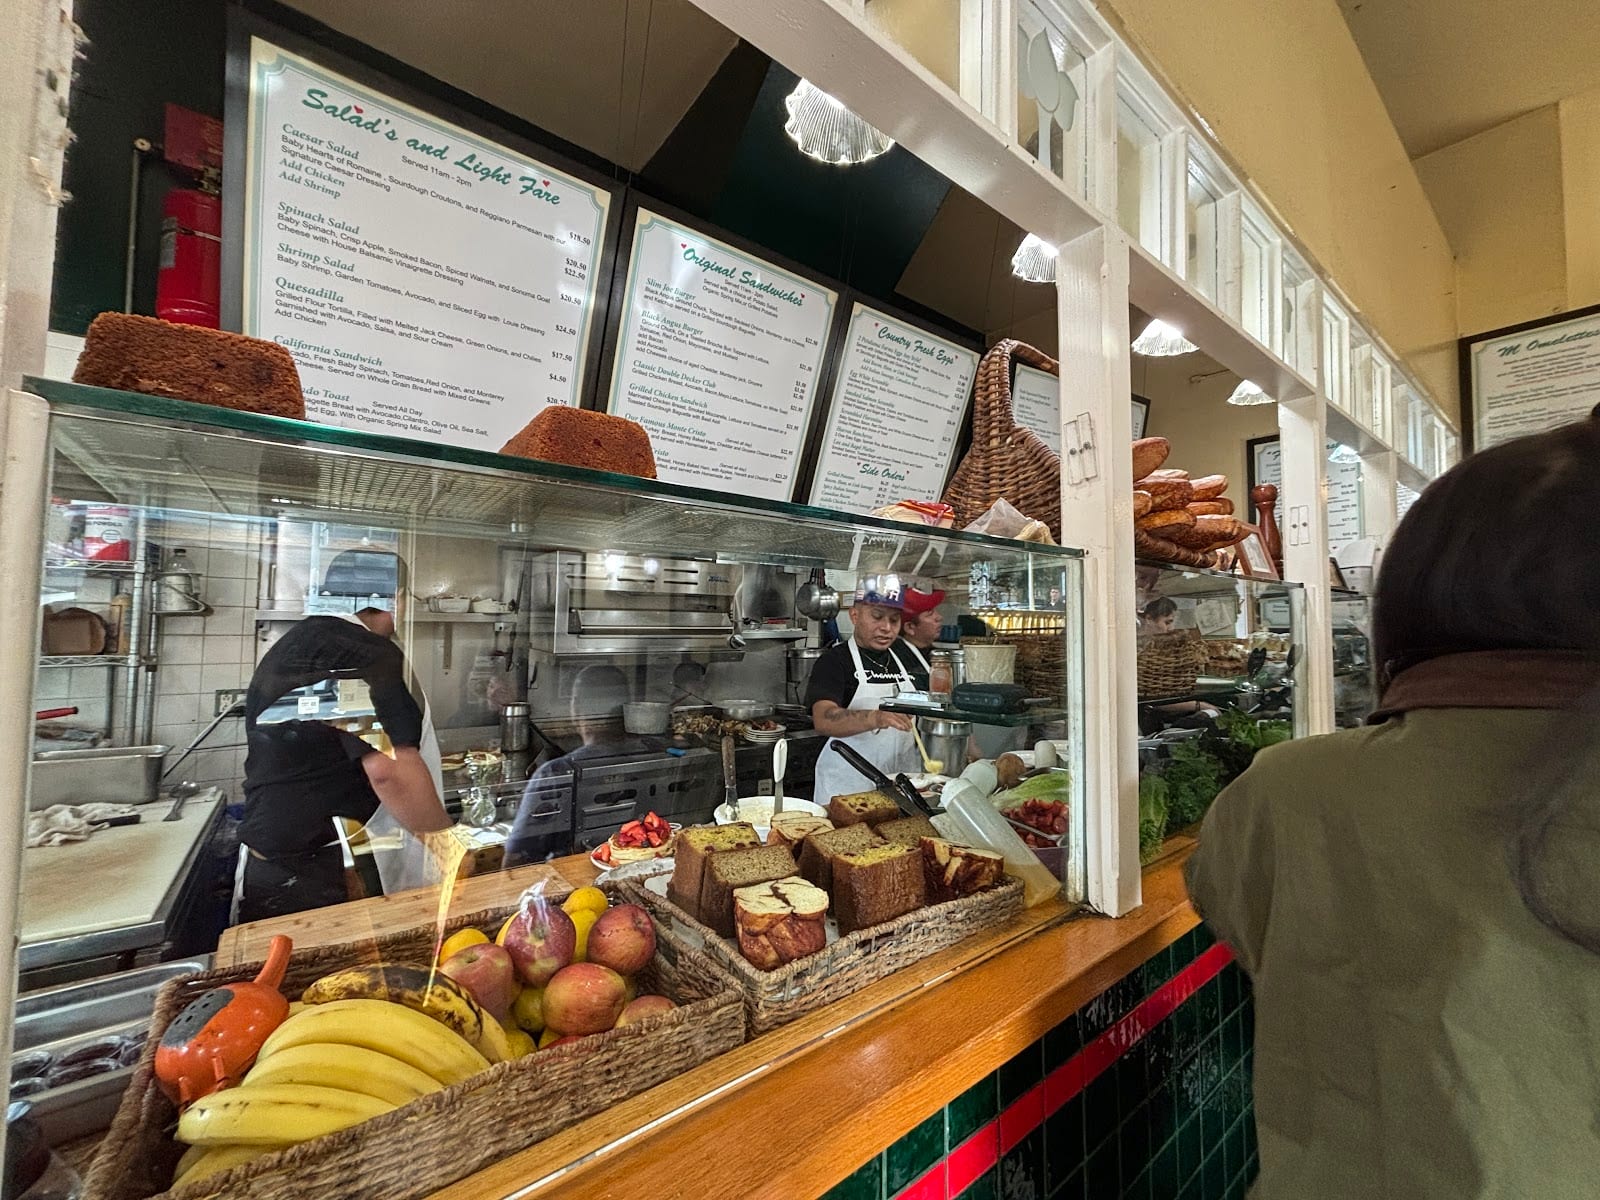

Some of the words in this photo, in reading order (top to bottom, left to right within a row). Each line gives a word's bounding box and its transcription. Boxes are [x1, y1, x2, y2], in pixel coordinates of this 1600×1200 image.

[282, 123, 325, 147] Caesar
[325, 140, 360, 161] Salad
[279, 157, 303, 172] Add
[303, 165, 345, 188] Chicken
[280, 144, 324, 167] Signature
[323, 161, 356, 178] Caesar
[355, 172, 391, 193] Dressing
[401, 154, 429, 172] Served
[405, 138, 450, 161] and
[453, 153, 512, 186] Light
[518, 175, 561, 206] Fare
[278, 170, 303, 185] Add
[303, 178, 341, 199] Shrimp
[281, 134, 305, 151] Baby
[305, 143, 335, 162] Hearts
[345, 159, 383, 179] Romaine
[387, 175, 429, 196] Sourdough
[464, 203, 479, 214] and
[479, 207, 511, 225] Reggiano
[511, 219, 543, 237] Parmesan
[543, 233, 556, 242] with
[277, 201, 325, 225] Spinach
[326, 217, 360, 235] Salad
[276, 222, 311, 239] Cheese
[311, 234, 330, 245] with
[330, 238, 358, 253] House
[358, 247, 394, 264] Balsamic
[394, 258, 433, 276] Vinaigrette
[433, 270, 465, 287] Dressing
[276, 242, 321, 264] Shrimp
[322, 255, 356, 273] Salad
[277, 212, 301, 228] Baby
[339, 232, 362, 246] Crisp
[387, 247, 419, 263] Smoked
[445, 265, 469, 279] Spiced
[497, 283, 511, 292] and
[510, 286, 536, 300] Sonoma
[536, 294, 551, 304] Goat
[275, 276, 345, 304] Quesadilla
[276, 253, 300, 268] Baby
[334, 270, 365, 285] Garden
[437, 300, 452, 309] and
[452, 303, 473, 315] Sliced
[473, 309, 487, 320] Egg
[487, 314, 501, 323] with
[519, 322, 546, 337] Dressing
[274, 307, 293, 318] Add
[293, 312, 328, 327] Chicken
[274, 289, 304, 303] Grilled
[304, 296, 327, 309] Flour
[356, 310, 378, 322] Filled
[378, 316, 394, 326] with
[394, 320, 420, 333] Melted
[419, 327, 437, 337] Jack
[465, 338, 486, 349] Green
[274, 298, 319, 316] Garnished
[319, 311, 337, 321] with
[397, 330, 412, 339] and
[412, 333, 430, 344] Sour
[430, 337, 454, 349] Cream
[273, 334, 331, 356] California
[332, 348, 383, 367] Sandwich
[877, 326, 912, 350] Country
[913, 339, 936, 357] Fresh
[935, 348, 954, 366] Eggs
[289, 350, 312, 361] cado,
[313, 353, 337, 365] Fresh
[337, 359, 358, 371] Baby
[462, 387, 476, 395] and
[475, 389, 505, 402] Monterey
[327, 365, 355, 377] Served
[366, 373, 391, 385] Whole
[390, 379, 411, 389] Grain
[411, 383, 433, 394] Bread
[432, 389, 447, 397] with
[447, 391, 468, 401] Mixed
[467, 395, 491, 406] Greens
[322, 389, 350, 402] Toast
[371, 400, 398, 412] Served
[397, 405, 408, 414] All
[408, 407, 423, 417] Day
[331, 401, 355, 412] Bread
[355, 406, 371, 414] with
[430, 420, 449, 429] Olive
[461, 425, 475, 434] Sea
[338, 410, 356, 420] With
[356, 413, 386, 425] Organic
[385, 419, 409, 431] Spring
[409, 423, 422, 432] Mix
[422, 426, 442, 436] Salad
[858, 463, 880, 477] Side
[880, 467, 905, 482] Orders
